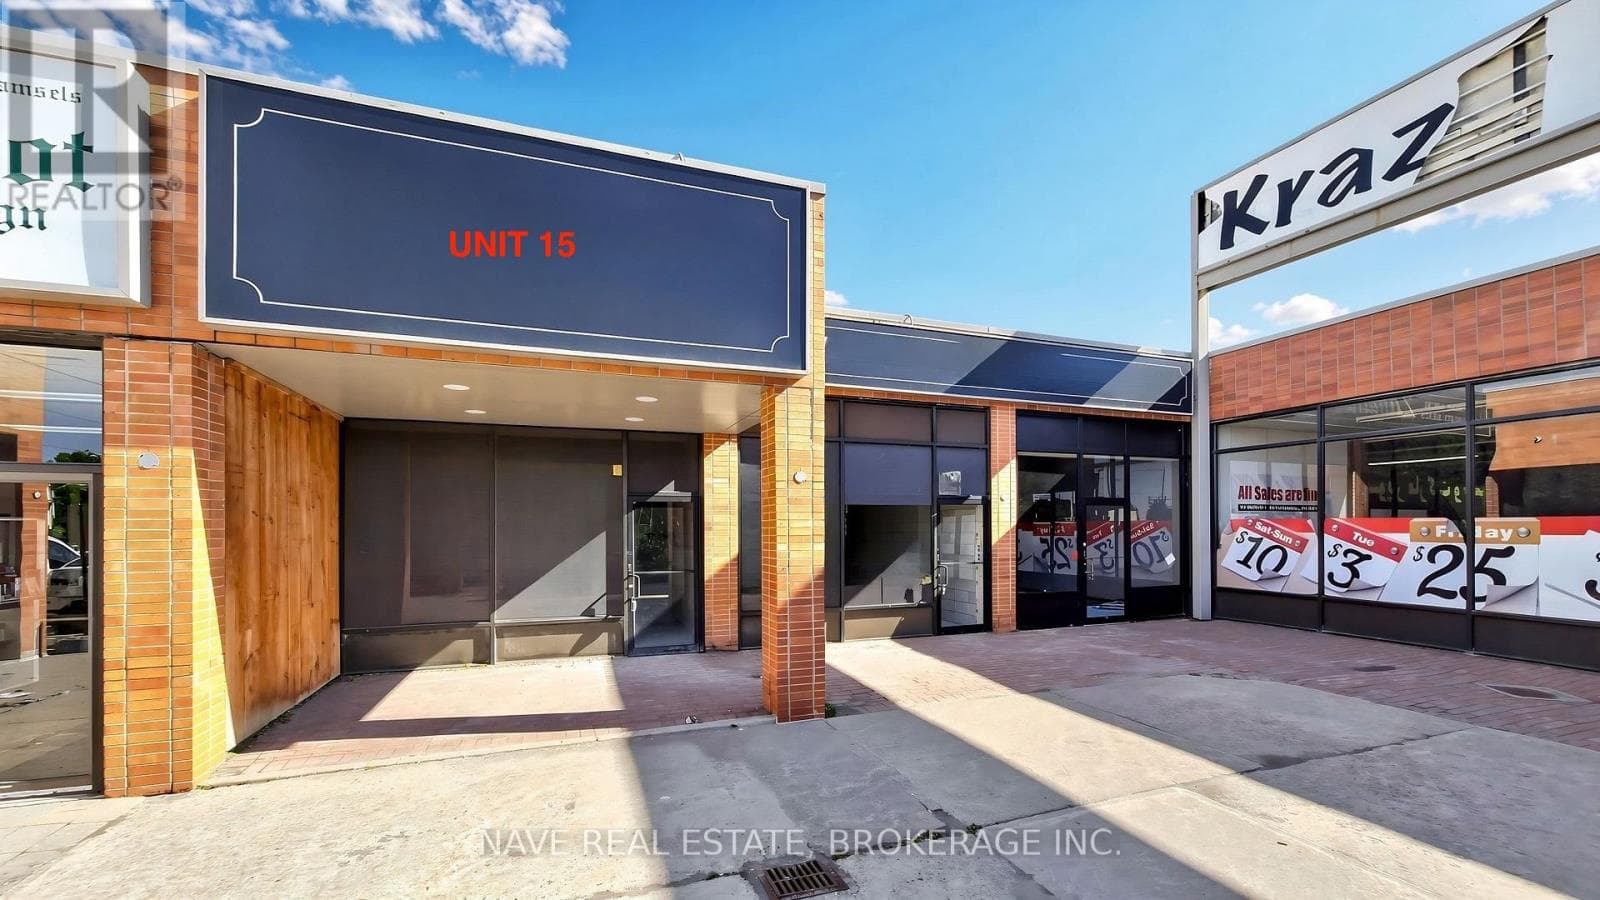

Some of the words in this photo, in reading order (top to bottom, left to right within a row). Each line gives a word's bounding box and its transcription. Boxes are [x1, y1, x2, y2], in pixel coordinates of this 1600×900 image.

[1238, 485, 1252, 500] All
[1254, 523, 1293, 545] Sat-Sun
[1352, 532, 1375, 548] Tue
[1236, 531, 1289, 576] $10
[1327, 543, 1373, 589] $3
[1412, 544, 1516, 603] $25
